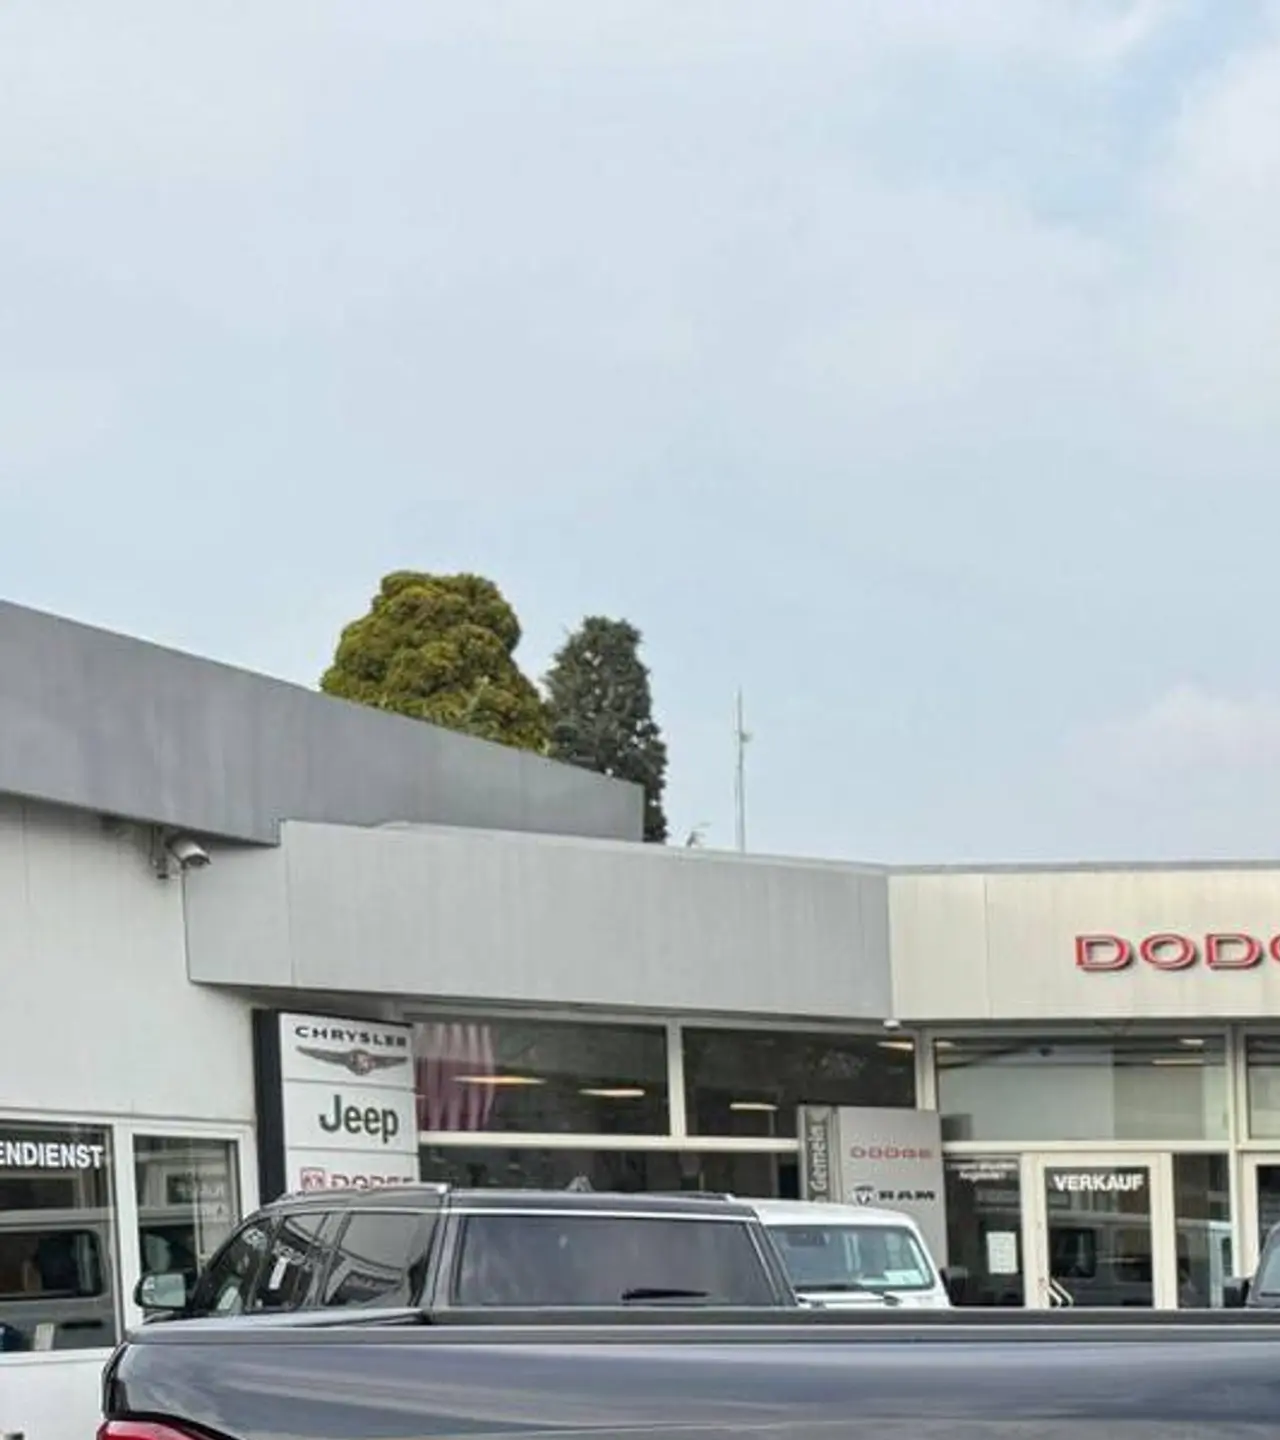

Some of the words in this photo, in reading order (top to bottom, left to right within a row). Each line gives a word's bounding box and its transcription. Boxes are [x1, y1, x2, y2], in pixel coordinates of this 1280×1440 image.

[294, 1025, 407, 1048] CHRYSLER
[318, 1094, 399, 1144] Jeep
[850, 1146, 932, 1159] DODGE
[1053, 1173, 1144, 1192] VERKAUF
[878, 1190, 935, 1201] RAM
